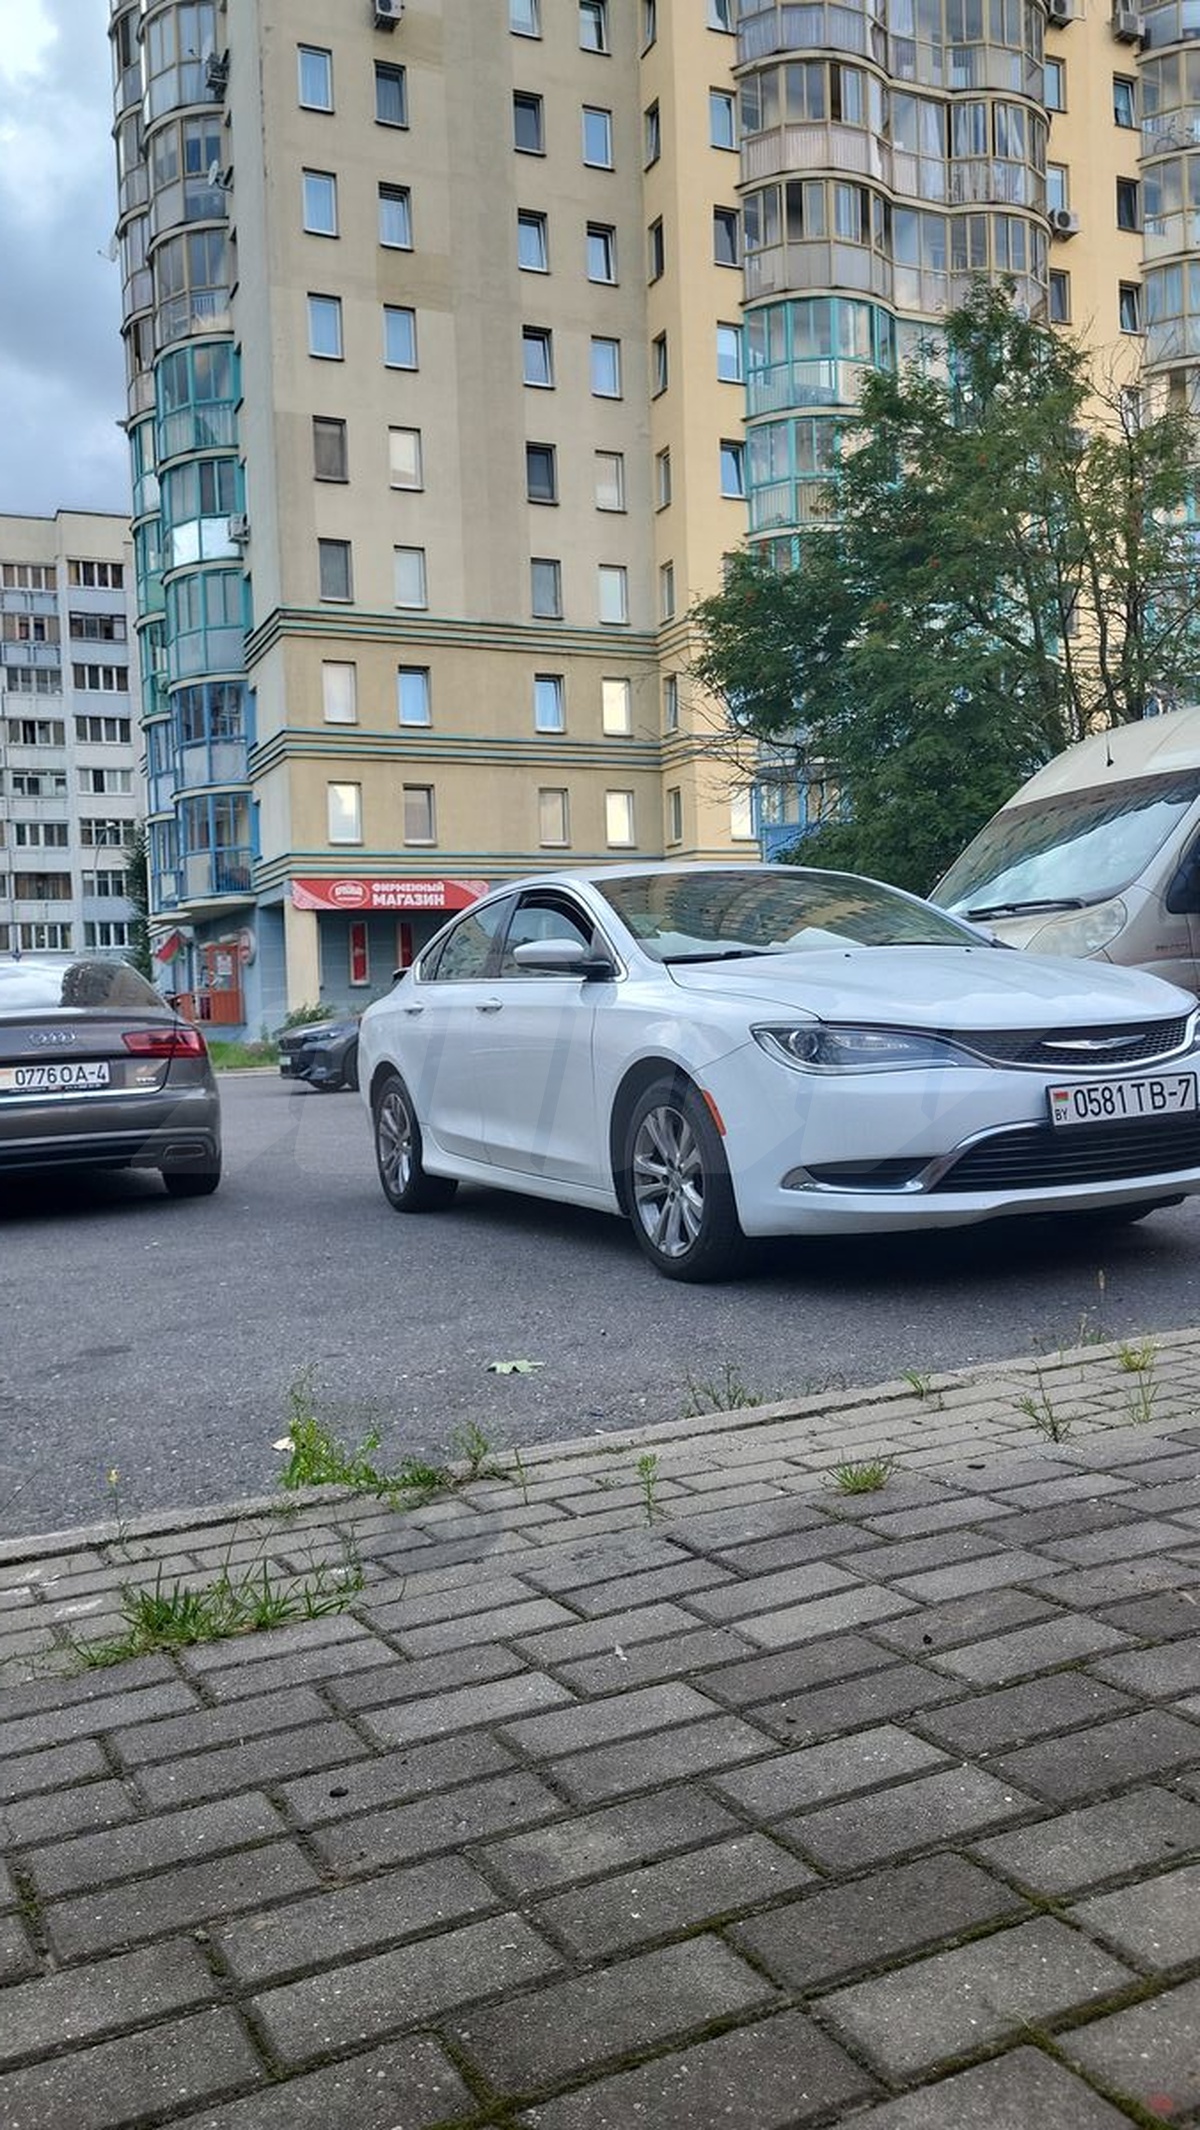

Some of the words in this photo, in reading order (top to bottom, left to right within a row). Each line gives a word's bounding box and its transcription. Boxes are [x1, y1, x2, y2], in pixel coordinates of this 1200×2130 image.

[372, 882, 445, 892] ФИРМЕННЫЙ
[372, 893, 445, 906] МАГАЗИН
[1055, 1107, 1068, 1121] BY
